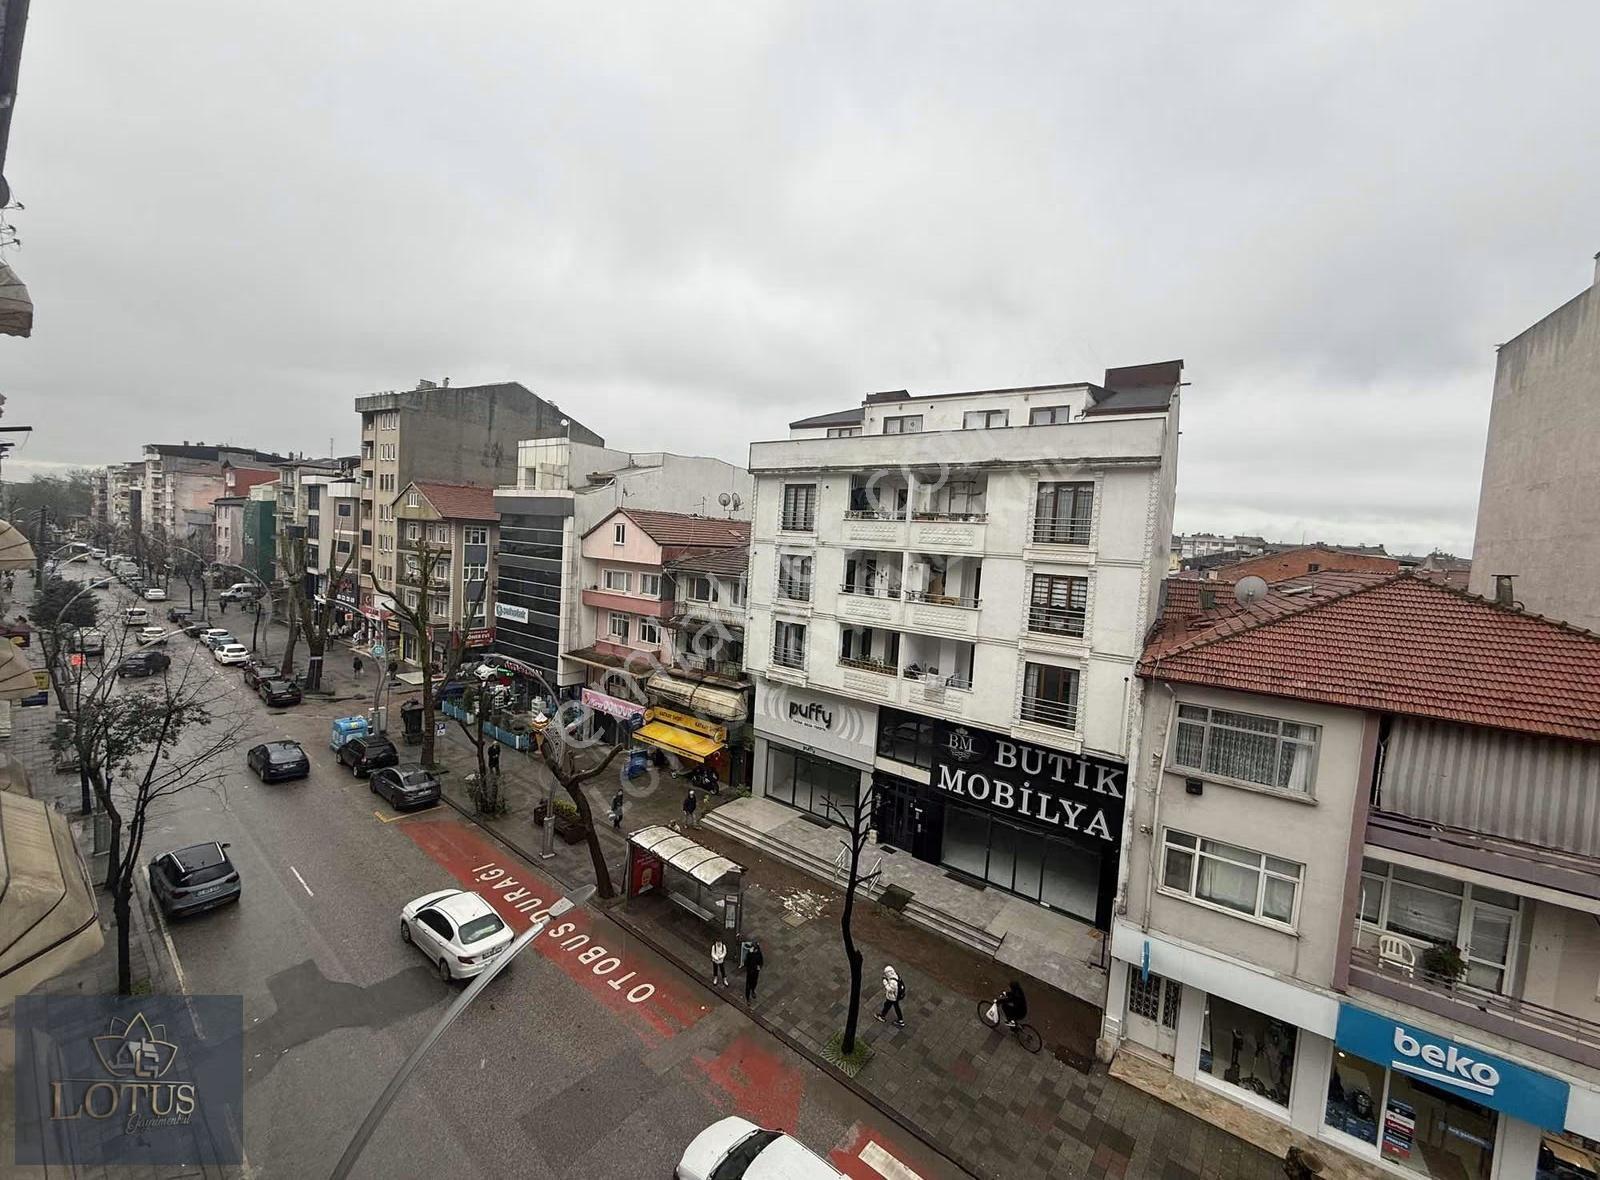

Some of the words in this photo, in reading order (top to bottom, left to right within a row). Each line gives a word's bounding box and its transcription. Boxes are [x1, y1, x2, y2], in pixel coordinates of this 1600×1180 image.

[789, 701, 832, 730] puffy
[949, 733, 974, 753] BM
[994, 739, 1125, 799] BUTİK
[937, 764, 1114, 842] MOBİLYA
[471, 862, 550, 924] DURAĞI
[548, 922, 656, 1003] OTOBÜS
[1394, 1026, 1500, 1087] beko
